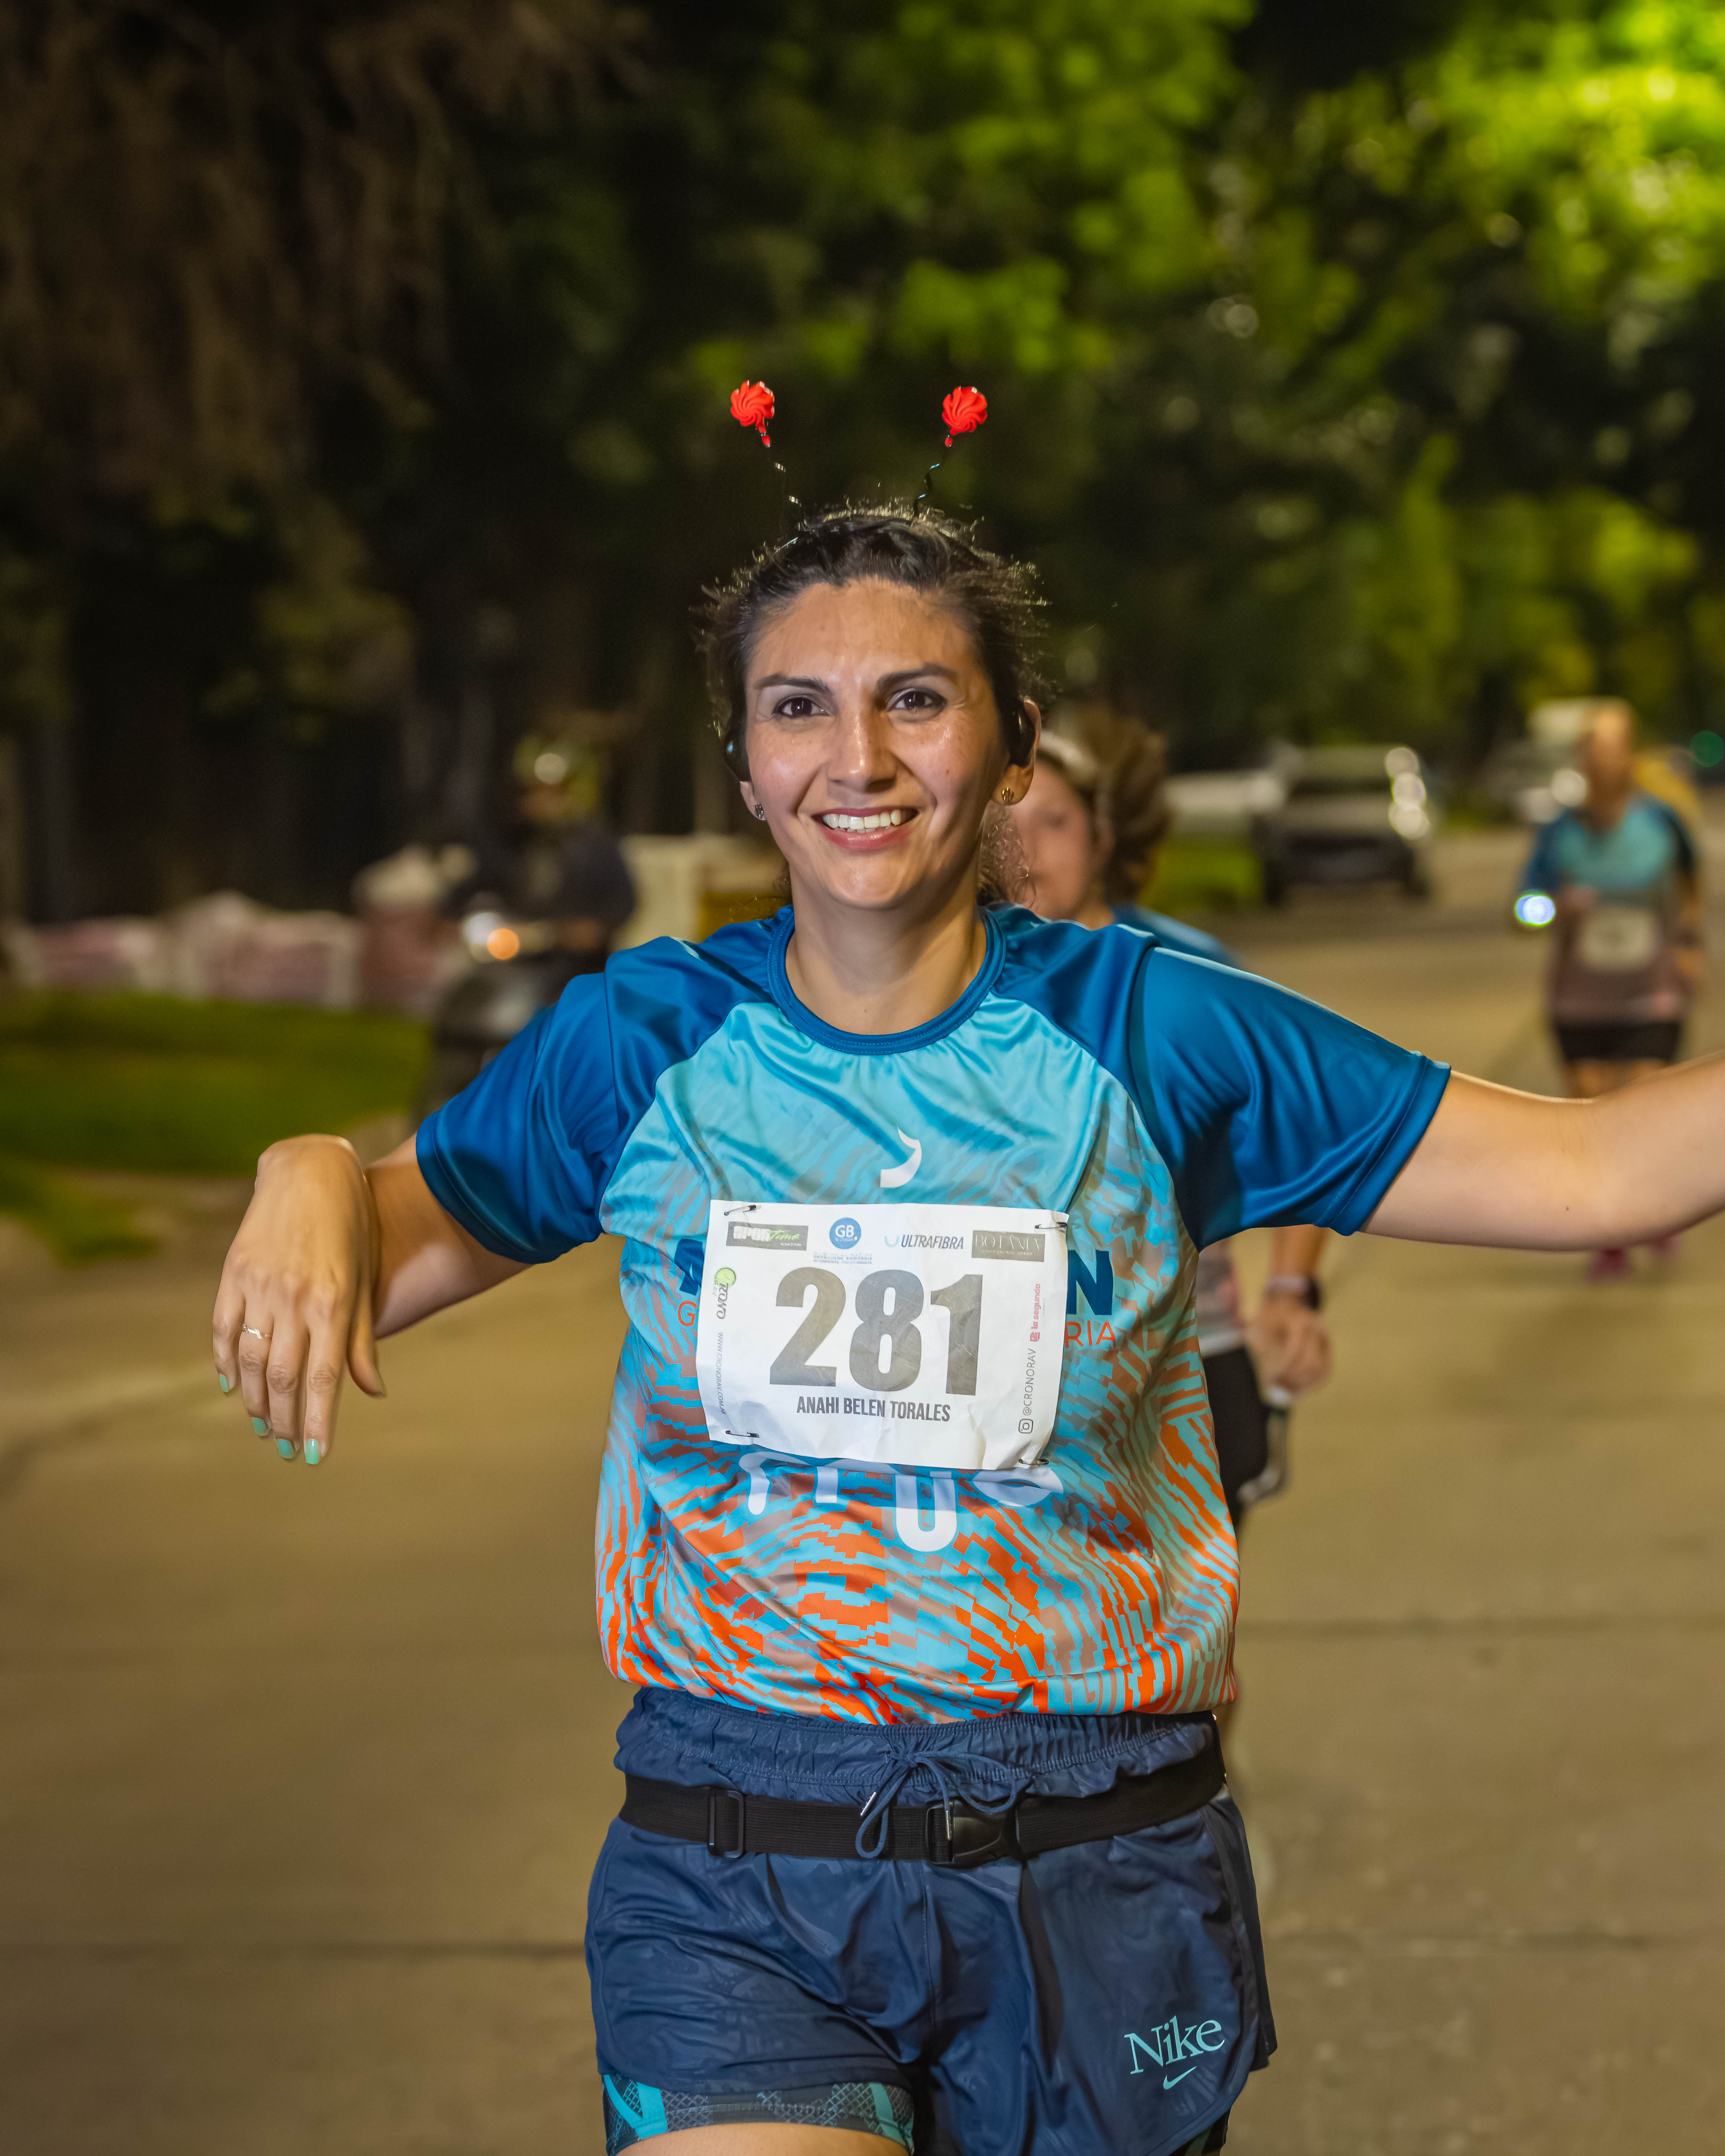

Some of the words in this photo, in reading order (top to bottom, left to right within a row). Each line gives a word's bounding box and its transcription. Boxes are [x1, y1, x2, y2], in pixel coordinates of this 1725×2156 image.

[901, 1234, 964, 1250] ULTRAFIBRA
[770, 1267, 983, 1396] 281
[797, 1396, 839, 1414] ANAHI
[843, 1397, 886, 1417] BELEN
[889, 1400, 951, 1422] TORALES
[1023, 1348, 1036, 1416] @CRONORAV
[1124, 2015, 1225, 2074] Nike
